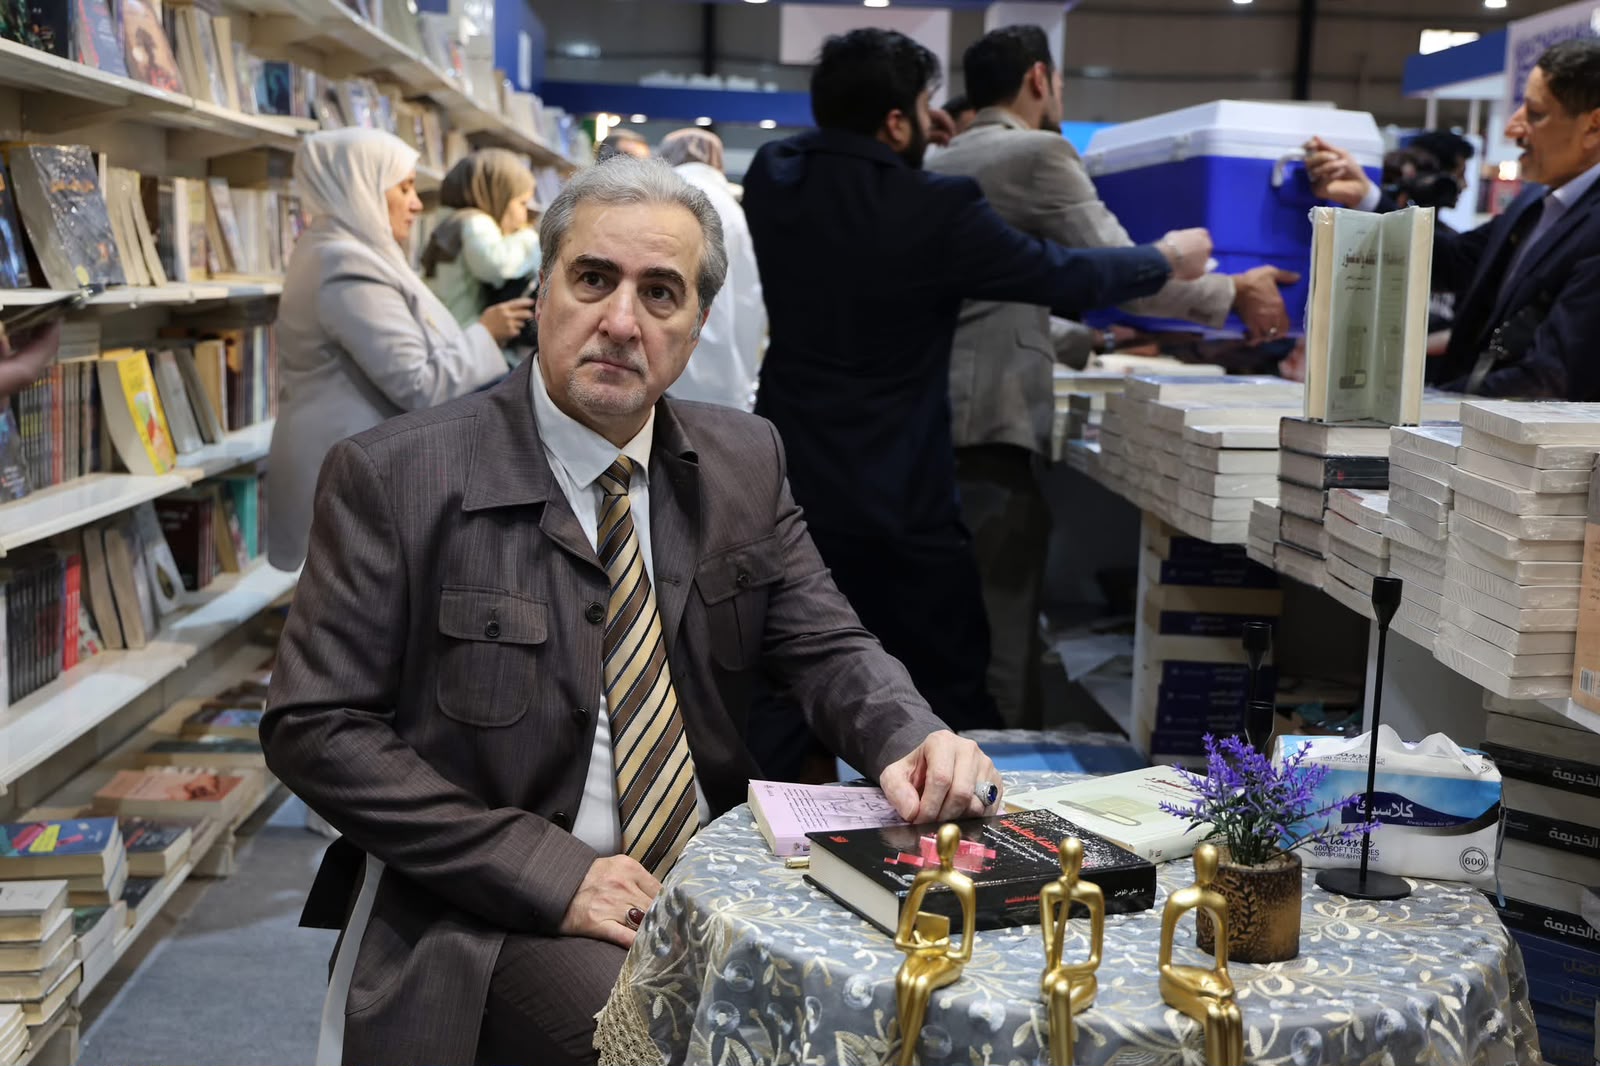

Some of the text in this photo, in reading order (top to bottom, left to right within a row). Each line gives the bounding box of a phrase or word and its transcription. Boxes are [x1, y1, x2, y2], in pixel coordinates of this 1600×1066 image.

[1548, 827, 1599, 849] الخديعة
[1350, 848, 1380, 856] TISES
[1465, 857, 1484, 866] 600
[1544, 916, 1594, 940] الخديعة
